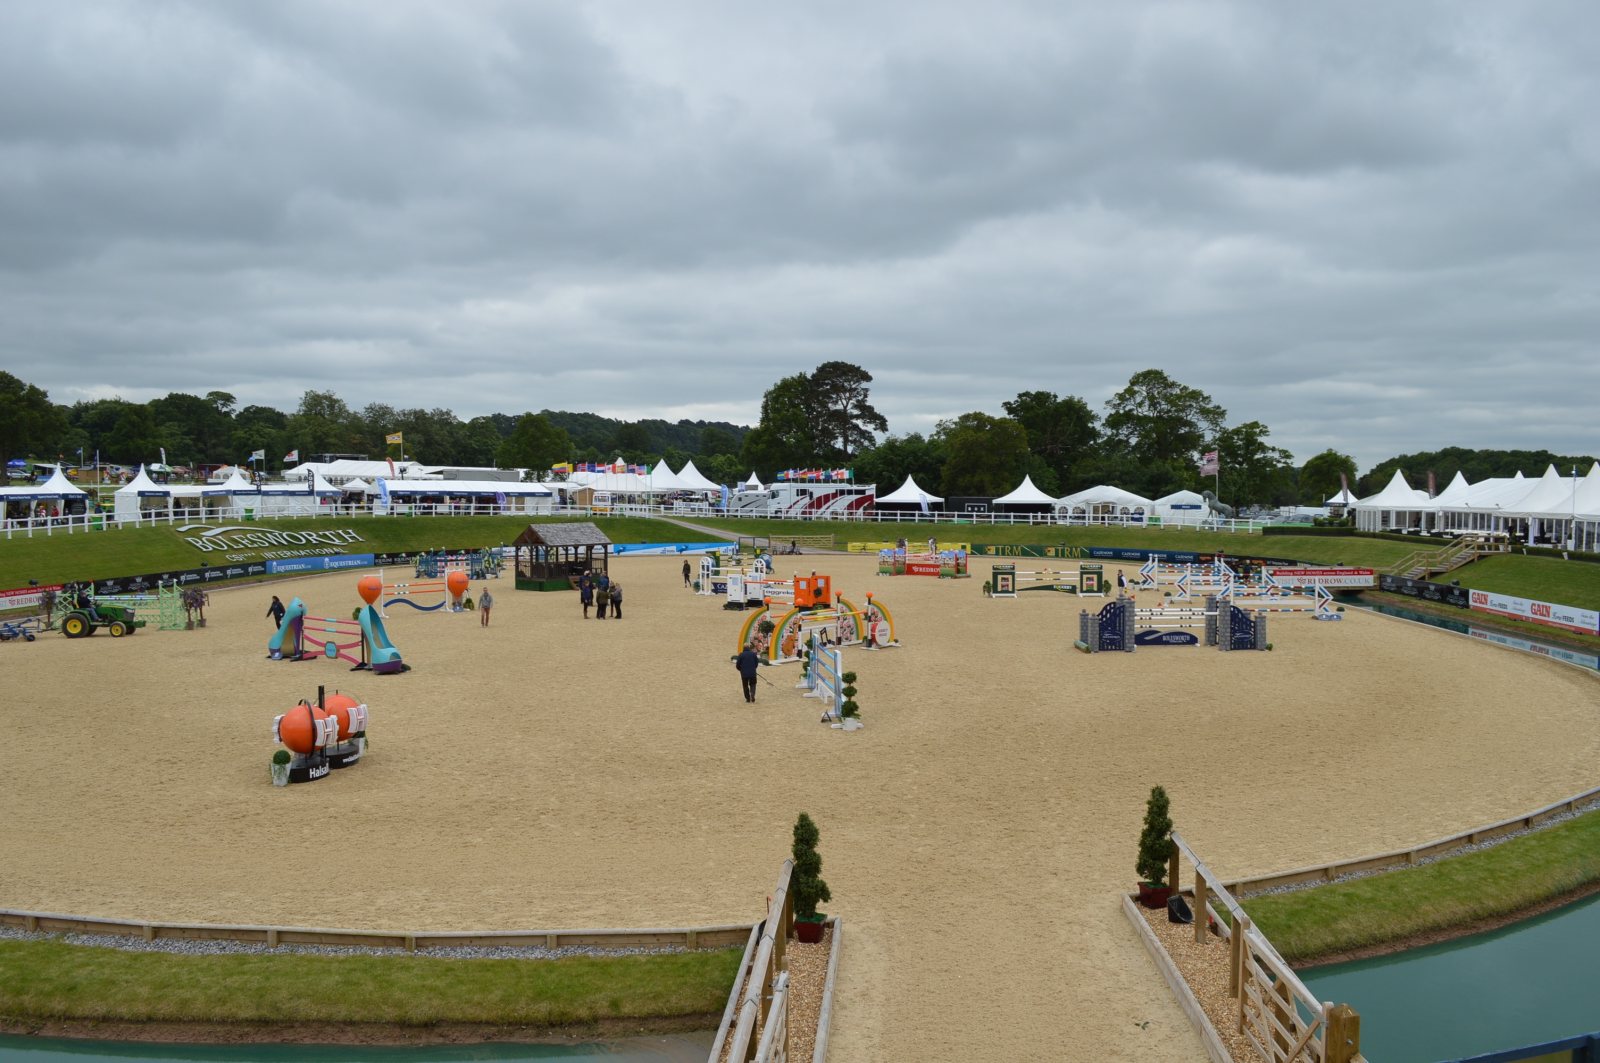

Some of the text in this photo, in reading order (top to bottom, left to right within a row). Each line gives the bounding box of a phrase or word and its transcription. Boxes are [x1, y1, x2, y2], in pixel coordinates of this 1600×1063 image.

[184, 529, 365, 552] BOLESWORTH
[261, 547, 349, 560] INTERNATIONAL
[995, 545, 1021, 556] TRM
[1057, 547, 1080, 558] TRM
[1471, 592, 1489, 606] GAIN
[1530, 602, 1552, 618] GAIN
